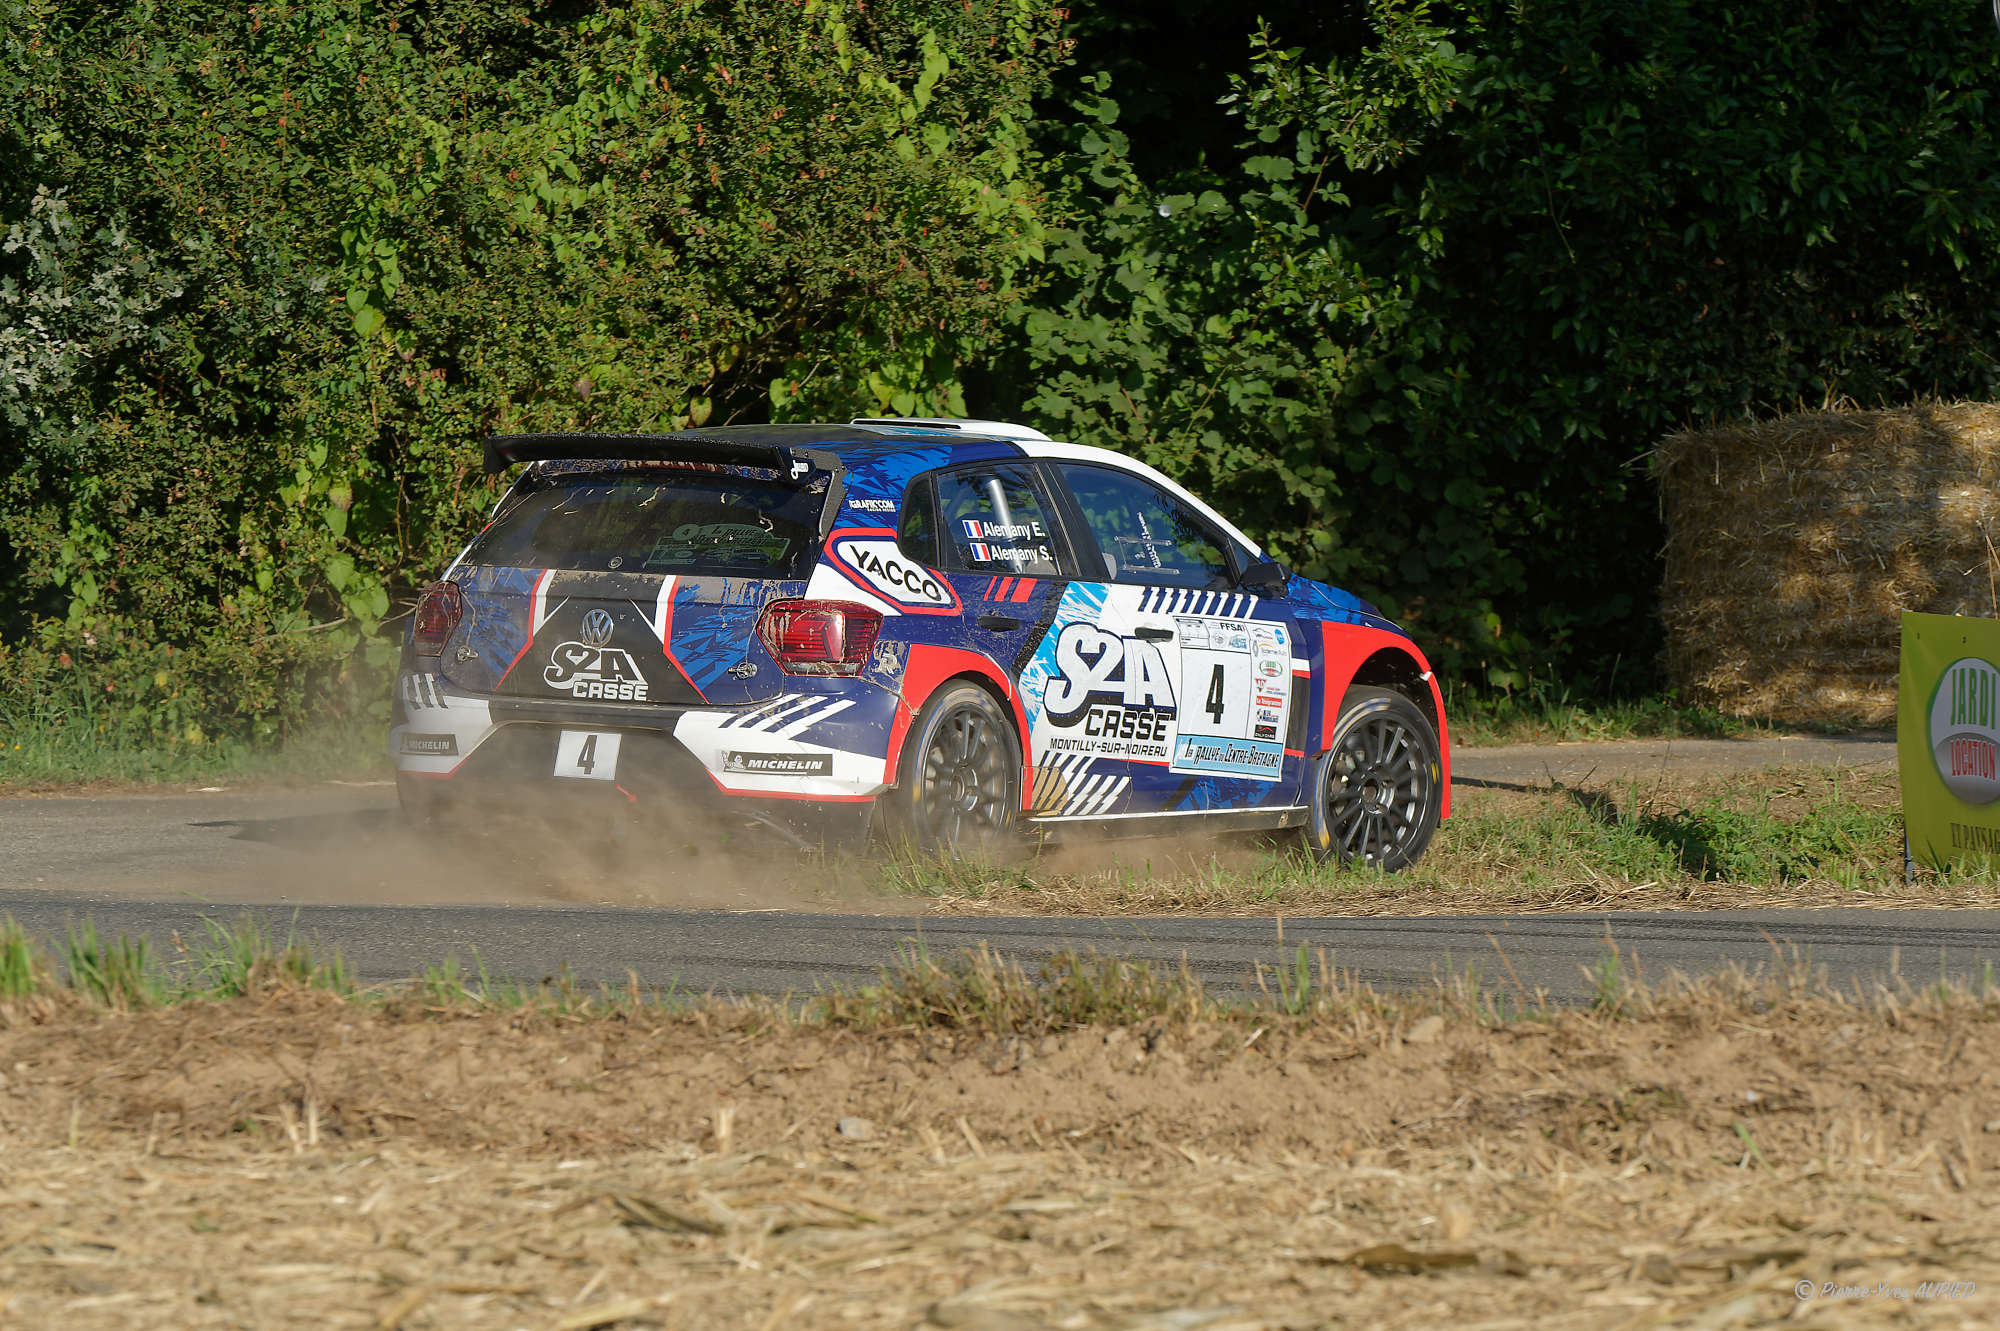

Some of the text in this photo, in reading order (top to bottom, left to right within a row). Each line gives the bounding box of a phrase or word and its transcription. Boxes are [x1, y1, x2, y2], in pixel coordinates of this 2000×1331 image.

[983, 521, 1046, 541] Alemany E.
[849, 544, 942, 601] YACCO
[991, 545, 1053, 564] Alemany S.
[1220, 622, 1244, 632] FFSA
[544, 641, 649, 689] S2A
[1043, 621, 1177, 727] S2A
[572, 681, 649, 701] CASSE
[1205, 664, 1225, 724] 4
[1950, 667, 1997, 730] JARDI
[1085, 708, 1171, 741] CASSE
[576, 734, 599, 775] 4
[747, 759, 824, 770] MICHELIN
[1049, 738, 1168, 757] MONTILLY-SUR-NOIREAU
[1950, 738, 1996, 780] LOCATION
